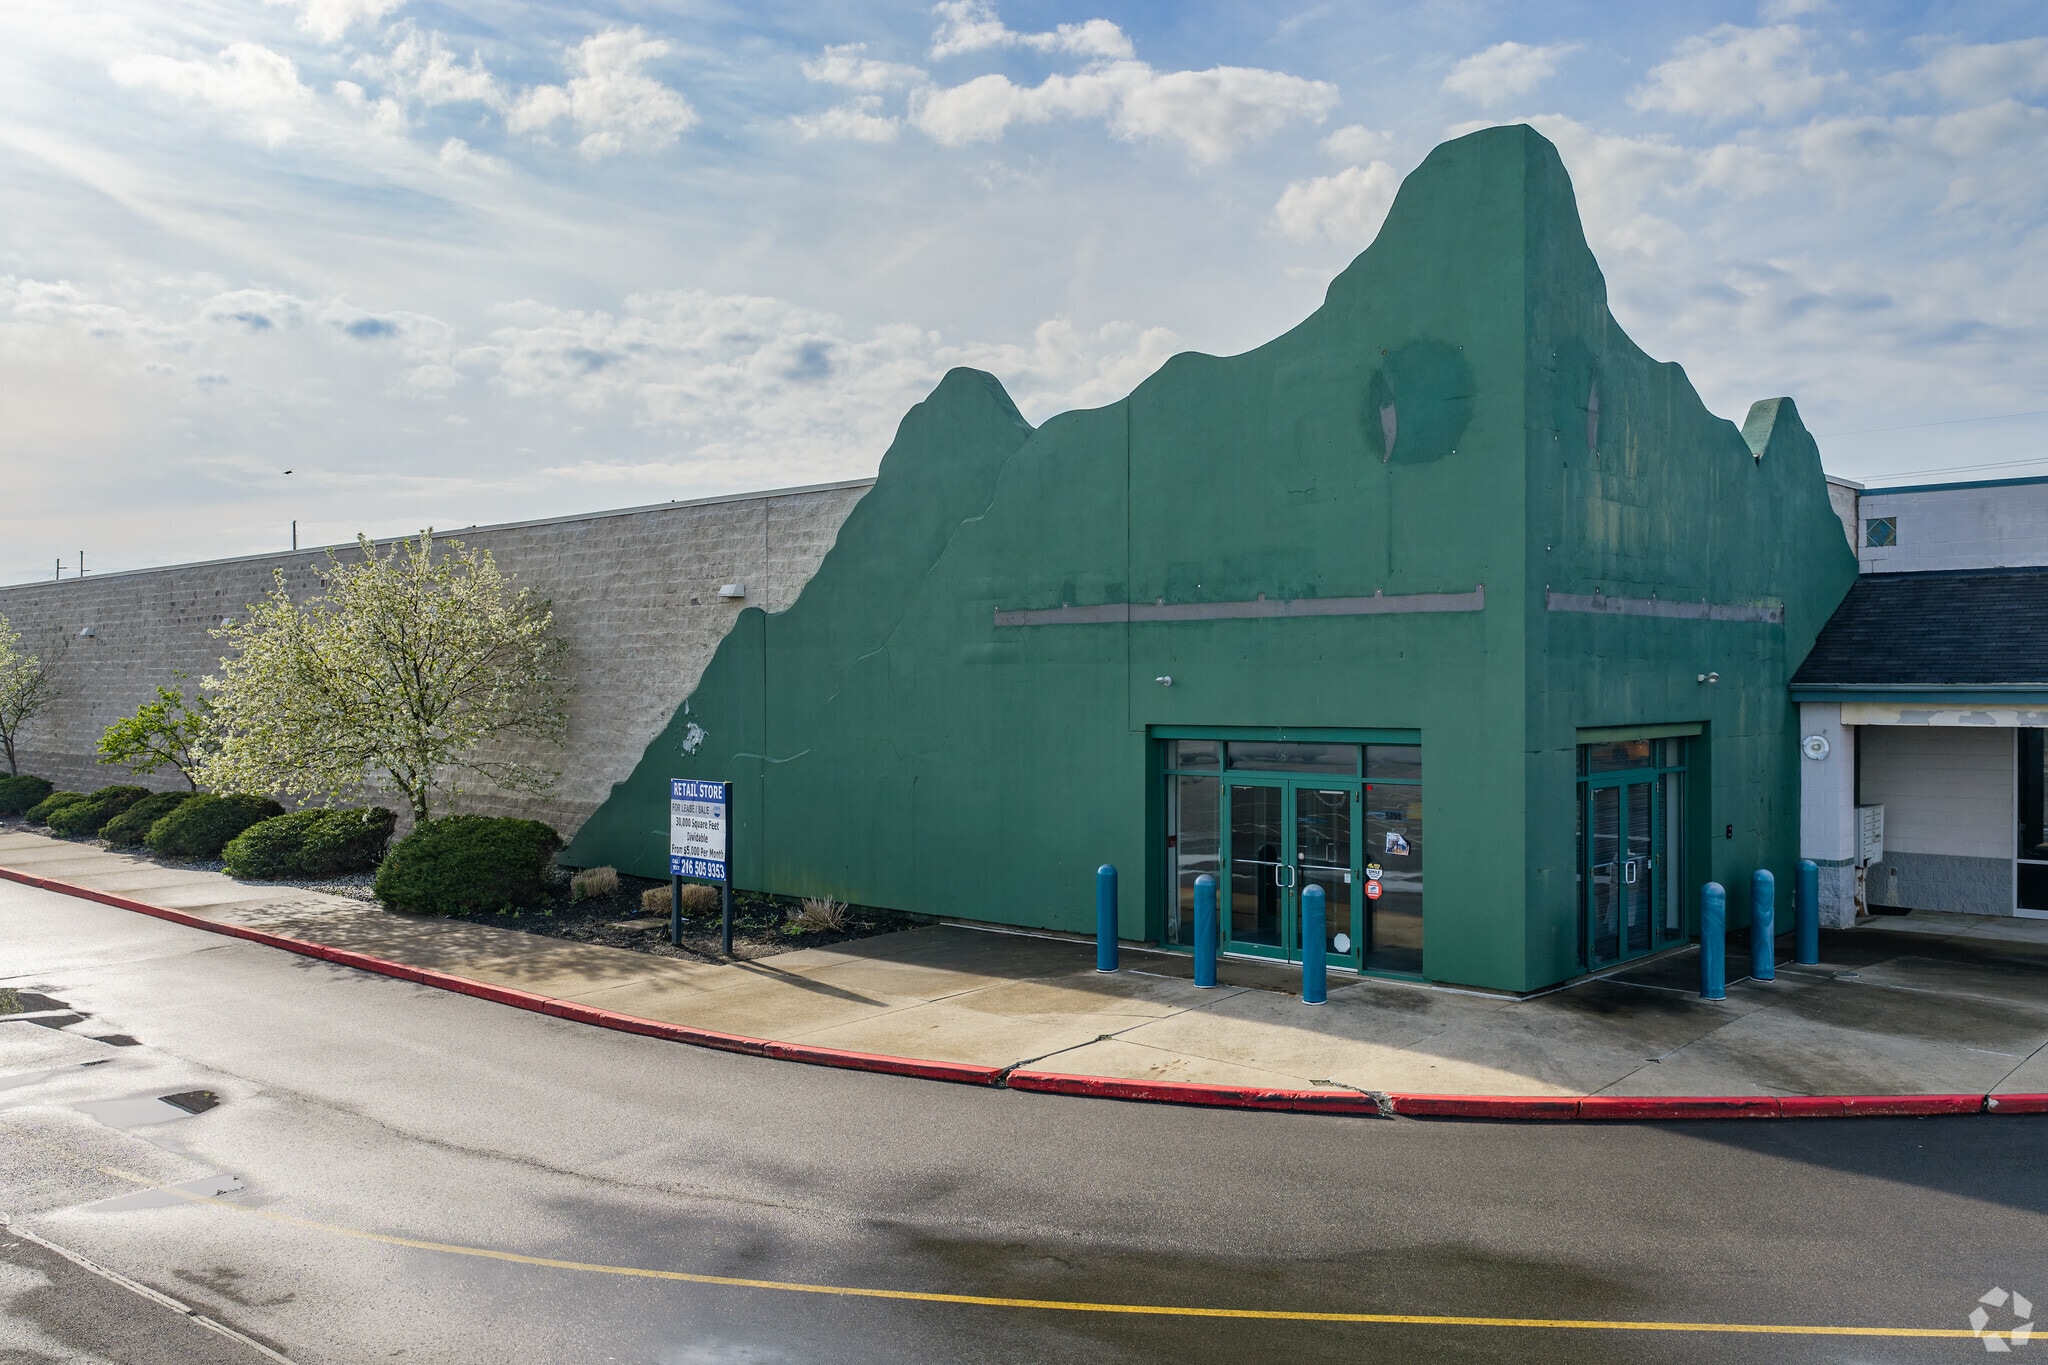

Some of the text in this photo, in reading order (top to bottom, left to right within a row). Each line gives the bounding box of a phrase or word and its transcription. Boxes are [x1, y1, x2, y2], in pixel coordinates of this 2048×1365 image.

[674, 782, 722, 799] RETAIL STORE
[681, 804, 695, 813] LEASE
[698, 806, 710, 814] SALE
[676, 817, 719, 830] 30,000 Square Feet
[672, 844, 682, 854] From
[683, 846, 700, 856] $5,000
[710, 849, 724, 859] Month
[681, 859, 724, 878] 216 505 9353
